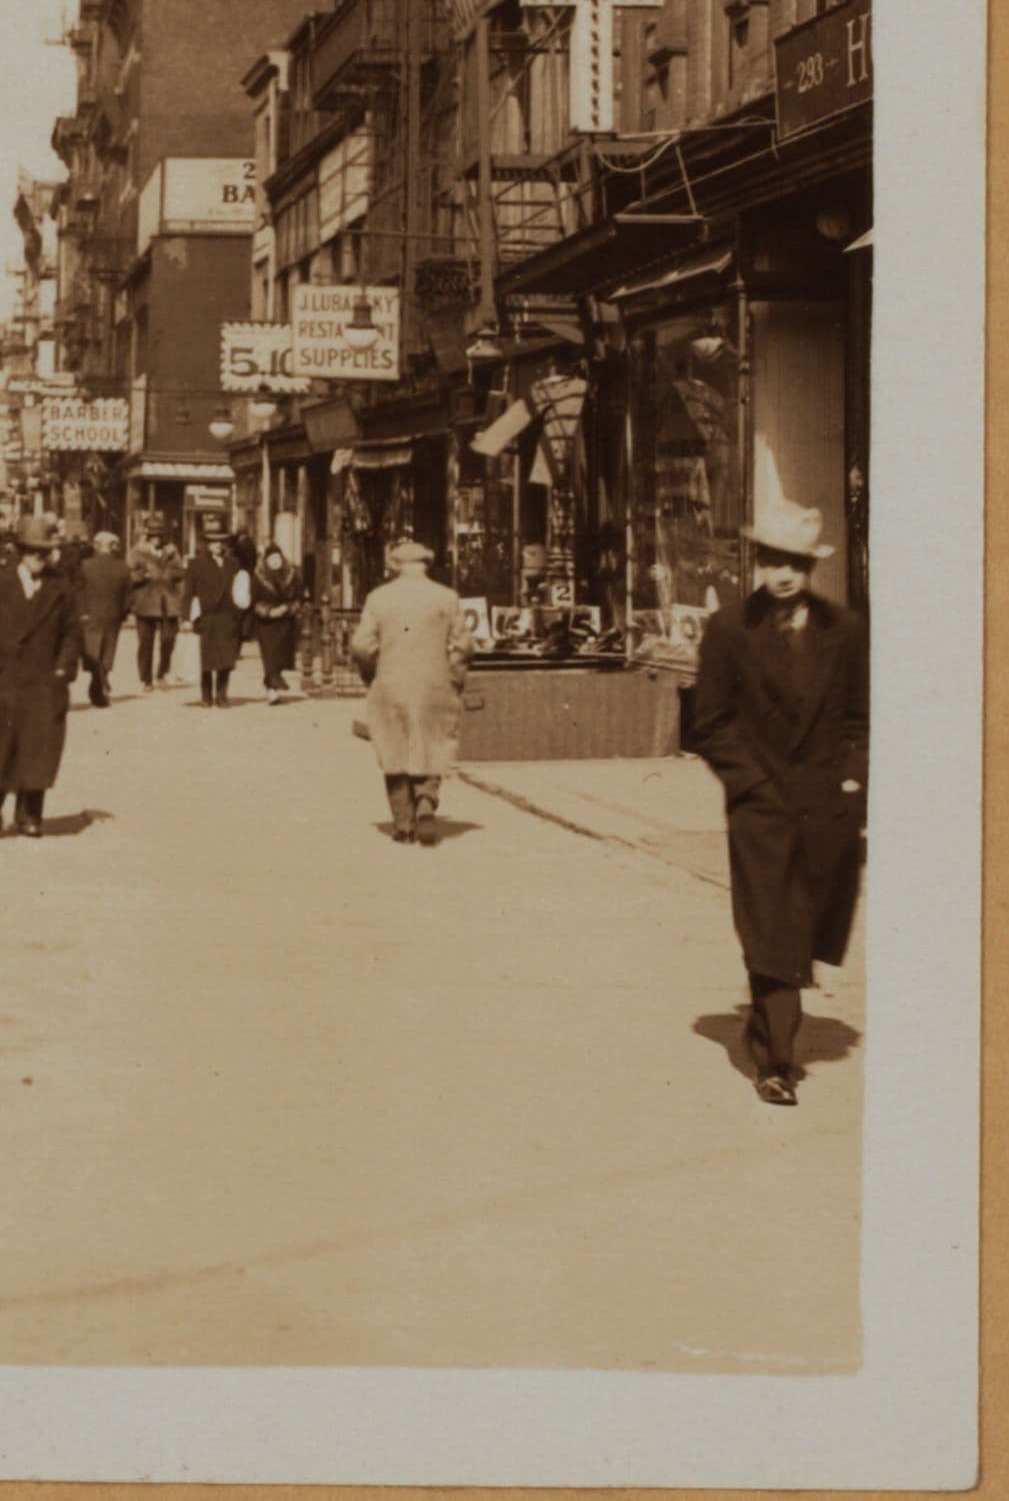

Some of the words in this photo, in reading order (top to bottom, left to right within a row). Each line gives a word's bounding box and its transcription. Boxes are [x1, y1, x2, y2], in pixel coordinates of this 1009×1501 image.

[796, 52, 824, 94] 293
[312, 291, 395, 314] LUBAKY
[298, 320, 395, 341] RESTANT
[299, 346, 394, 370] SUPPLIES
[50, 404, 123, 420] BARBER
[49, 426, 121, 442] SCHOOL
